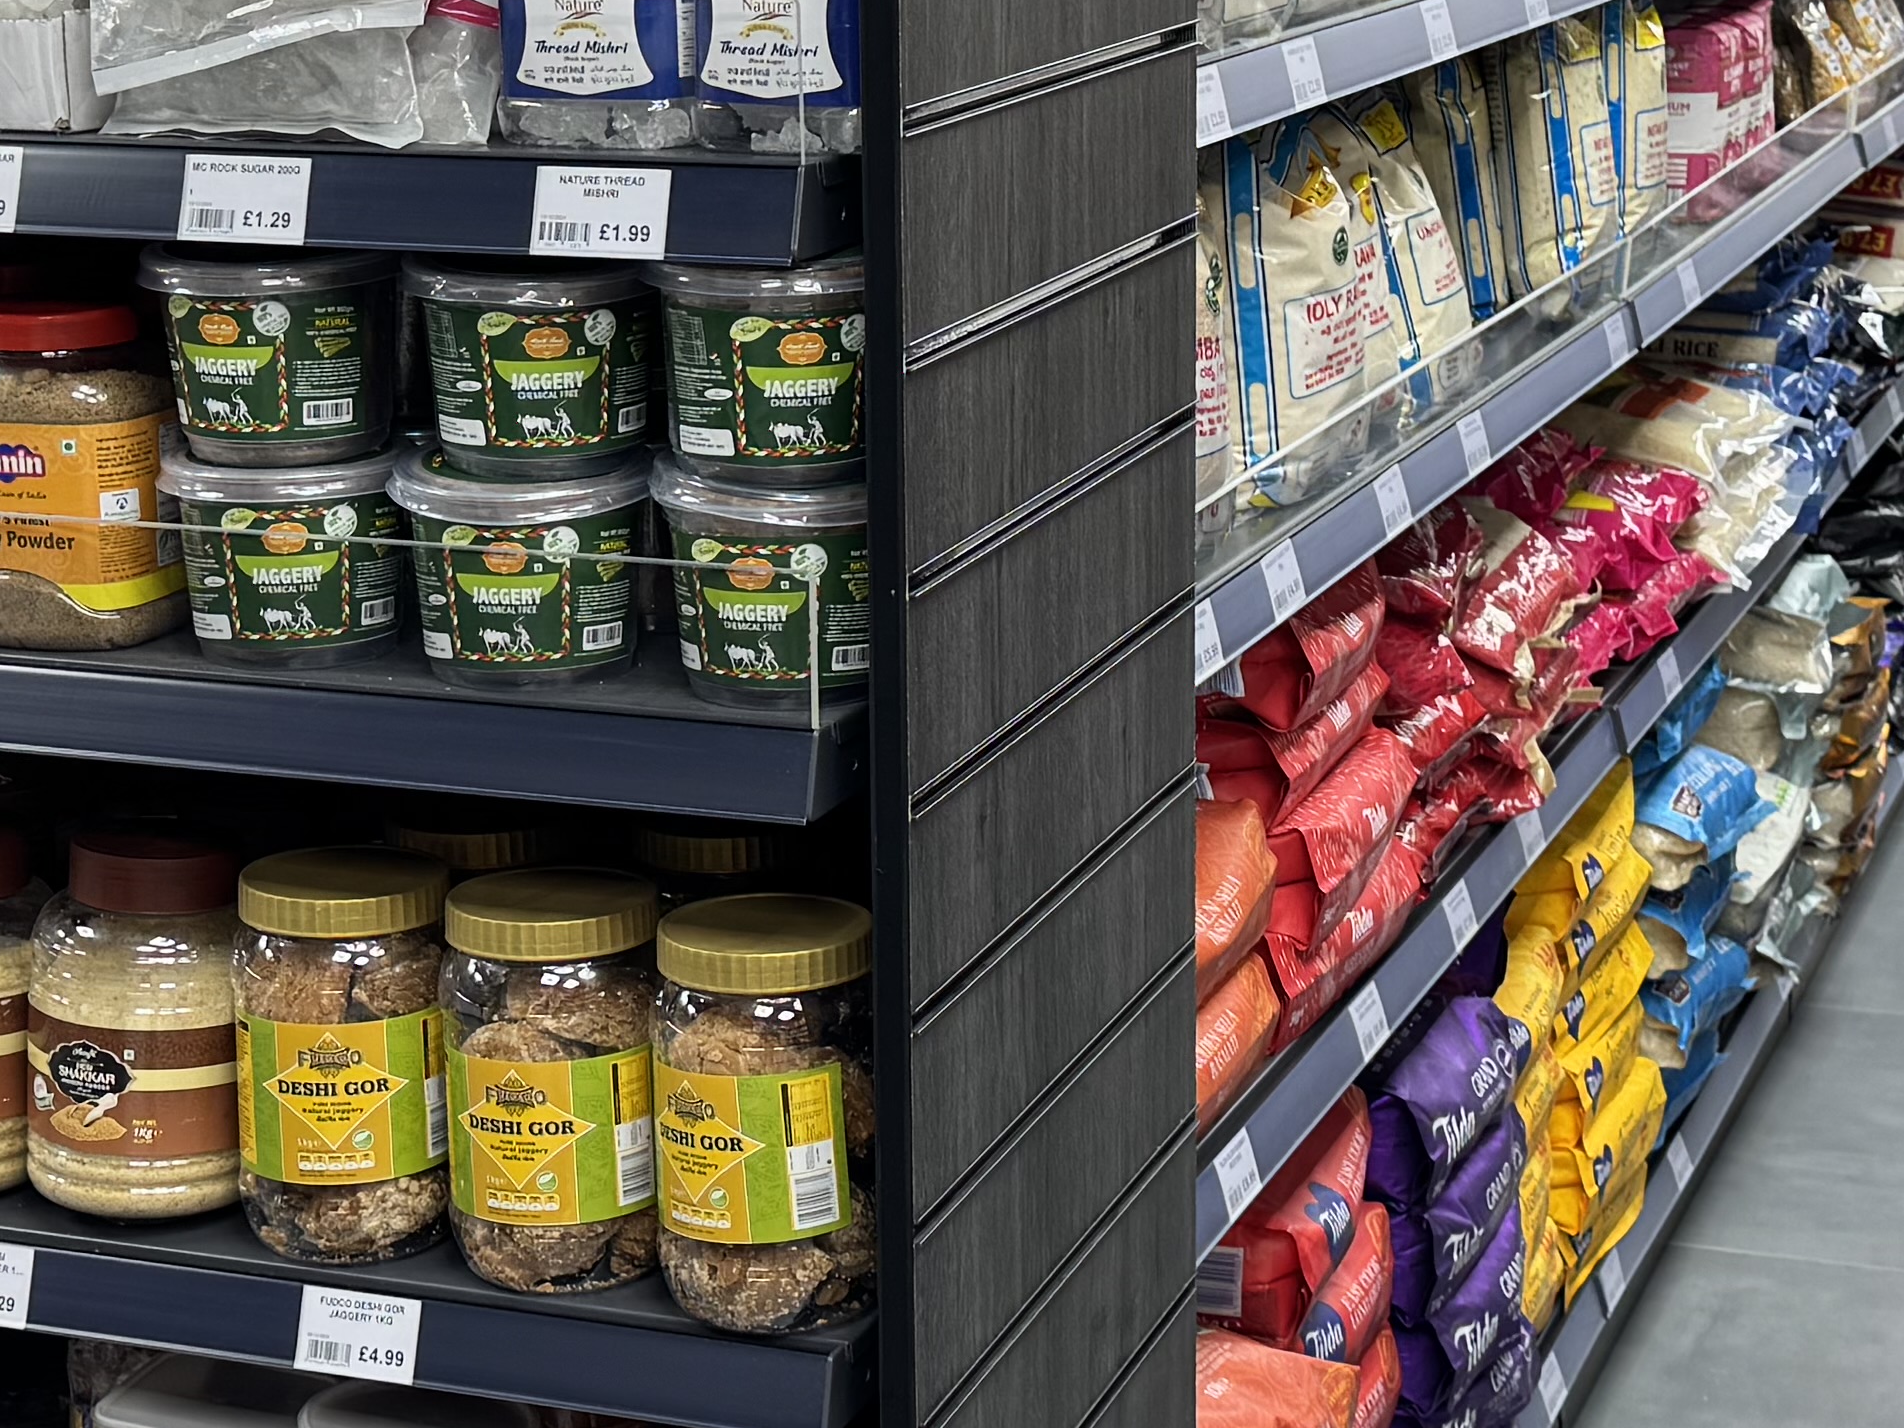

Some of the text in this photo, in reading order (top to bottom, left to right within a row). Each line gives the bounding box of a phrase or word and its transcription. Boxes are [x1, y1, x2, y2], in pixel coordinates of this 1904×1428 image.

[534, 40, 628, 54] Thread Mishri
[559, 174, 645, 187] NATURE THREAD
[243, 210, 291, 229] £1.29
[599, 224, 651, 242] £1.99
[510, 371, 585, 393] JAGGERY
[764, 377, 839, 401] JAGGERY
[6, 531, 75, 552] Powder
[252, 566, 324, 587] JAGGERY
[473, 587, 542, 608] JAGGERY
[719, 601, 789, 624] JAGGERY
[57, 1065, 116, 1086] SHAKKAR
[278, 1078, 390, 1097] DESHI GOR
[469, 1114, 575, 1135] DESHI GOR
[1434, 1107, 1476, 1163] Tilda
[700, 1134, 743, 1154] GOR
[1320, 1199, 1351, 1244] Tilda
[1306, 1321, 1344, 1362] Tilda
[1455, 1312, 1498, 1370] Tilda
[358, 1347, 404, 1368] £4.99
